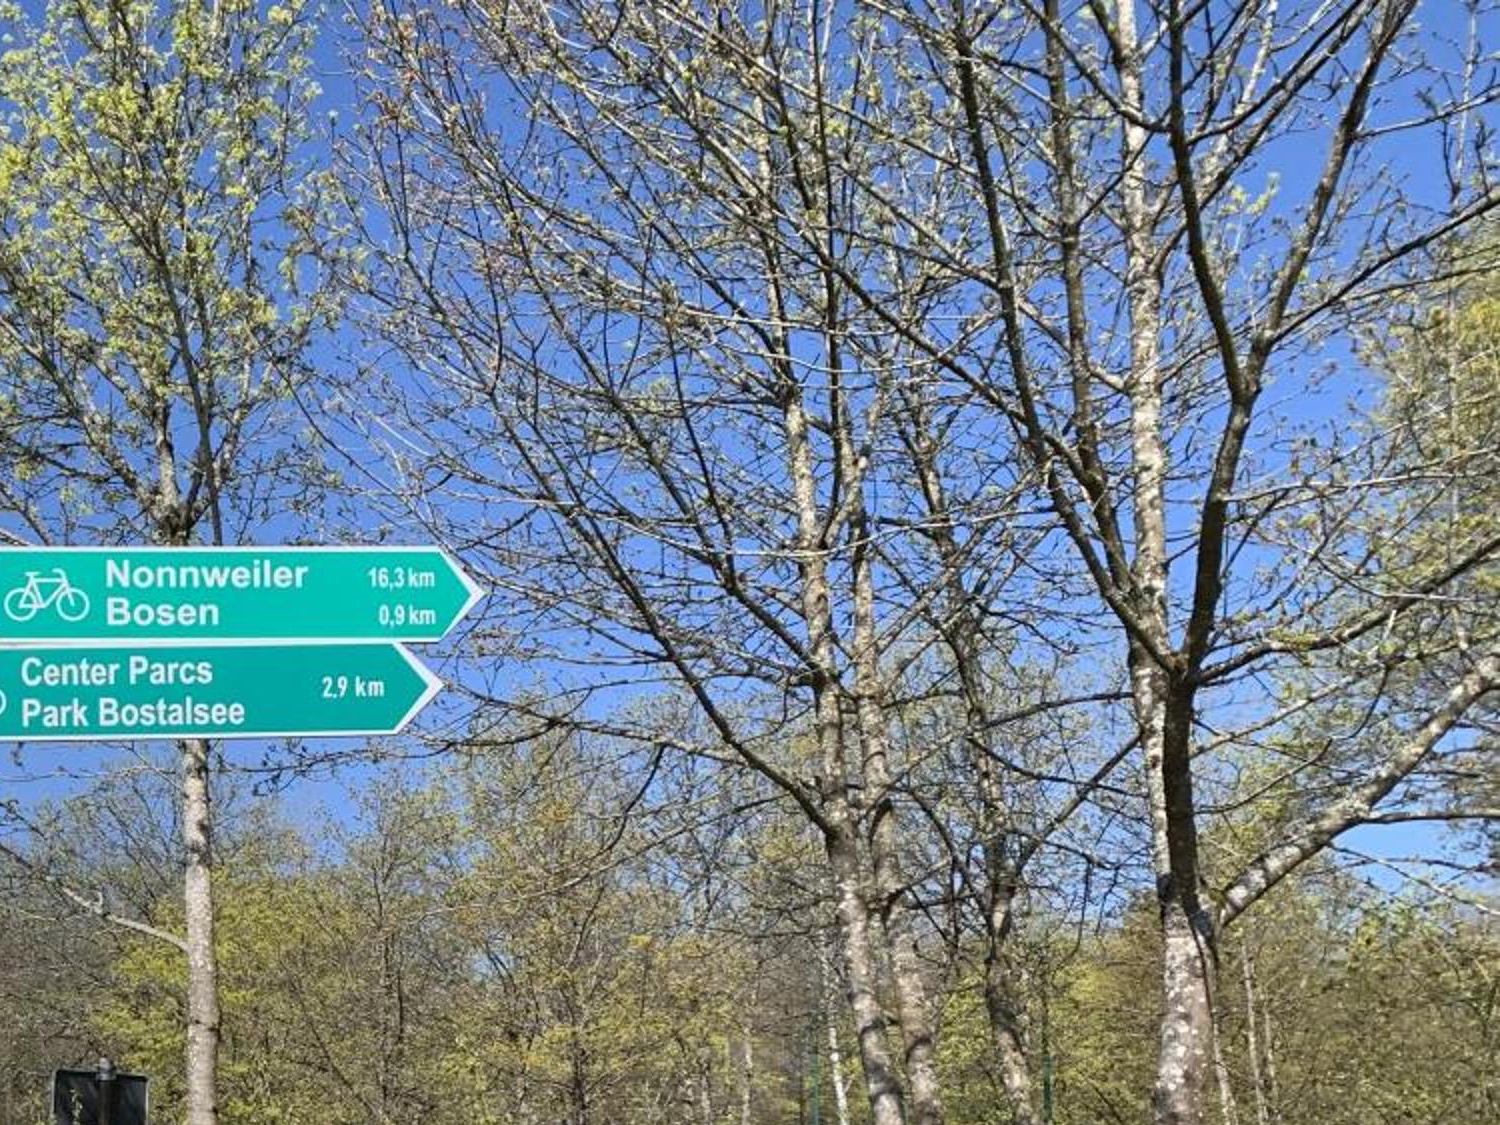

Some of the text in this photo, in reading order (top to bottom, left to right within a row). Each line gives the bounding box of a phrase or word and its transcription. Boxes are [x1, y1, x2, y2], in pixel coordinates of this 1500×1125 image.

[106, 559, 308, 588] Nonnweiler
[367, 567, 405, 592] 16,3
[106, 597, 220, 626] Bosen
[379, 604, 437, 629] 0,9 km
[20, 655, 214, 687] Center Parcs
[354, 676, 386, 698] km
[21, 697, 246, 729] Park Bostalsee
